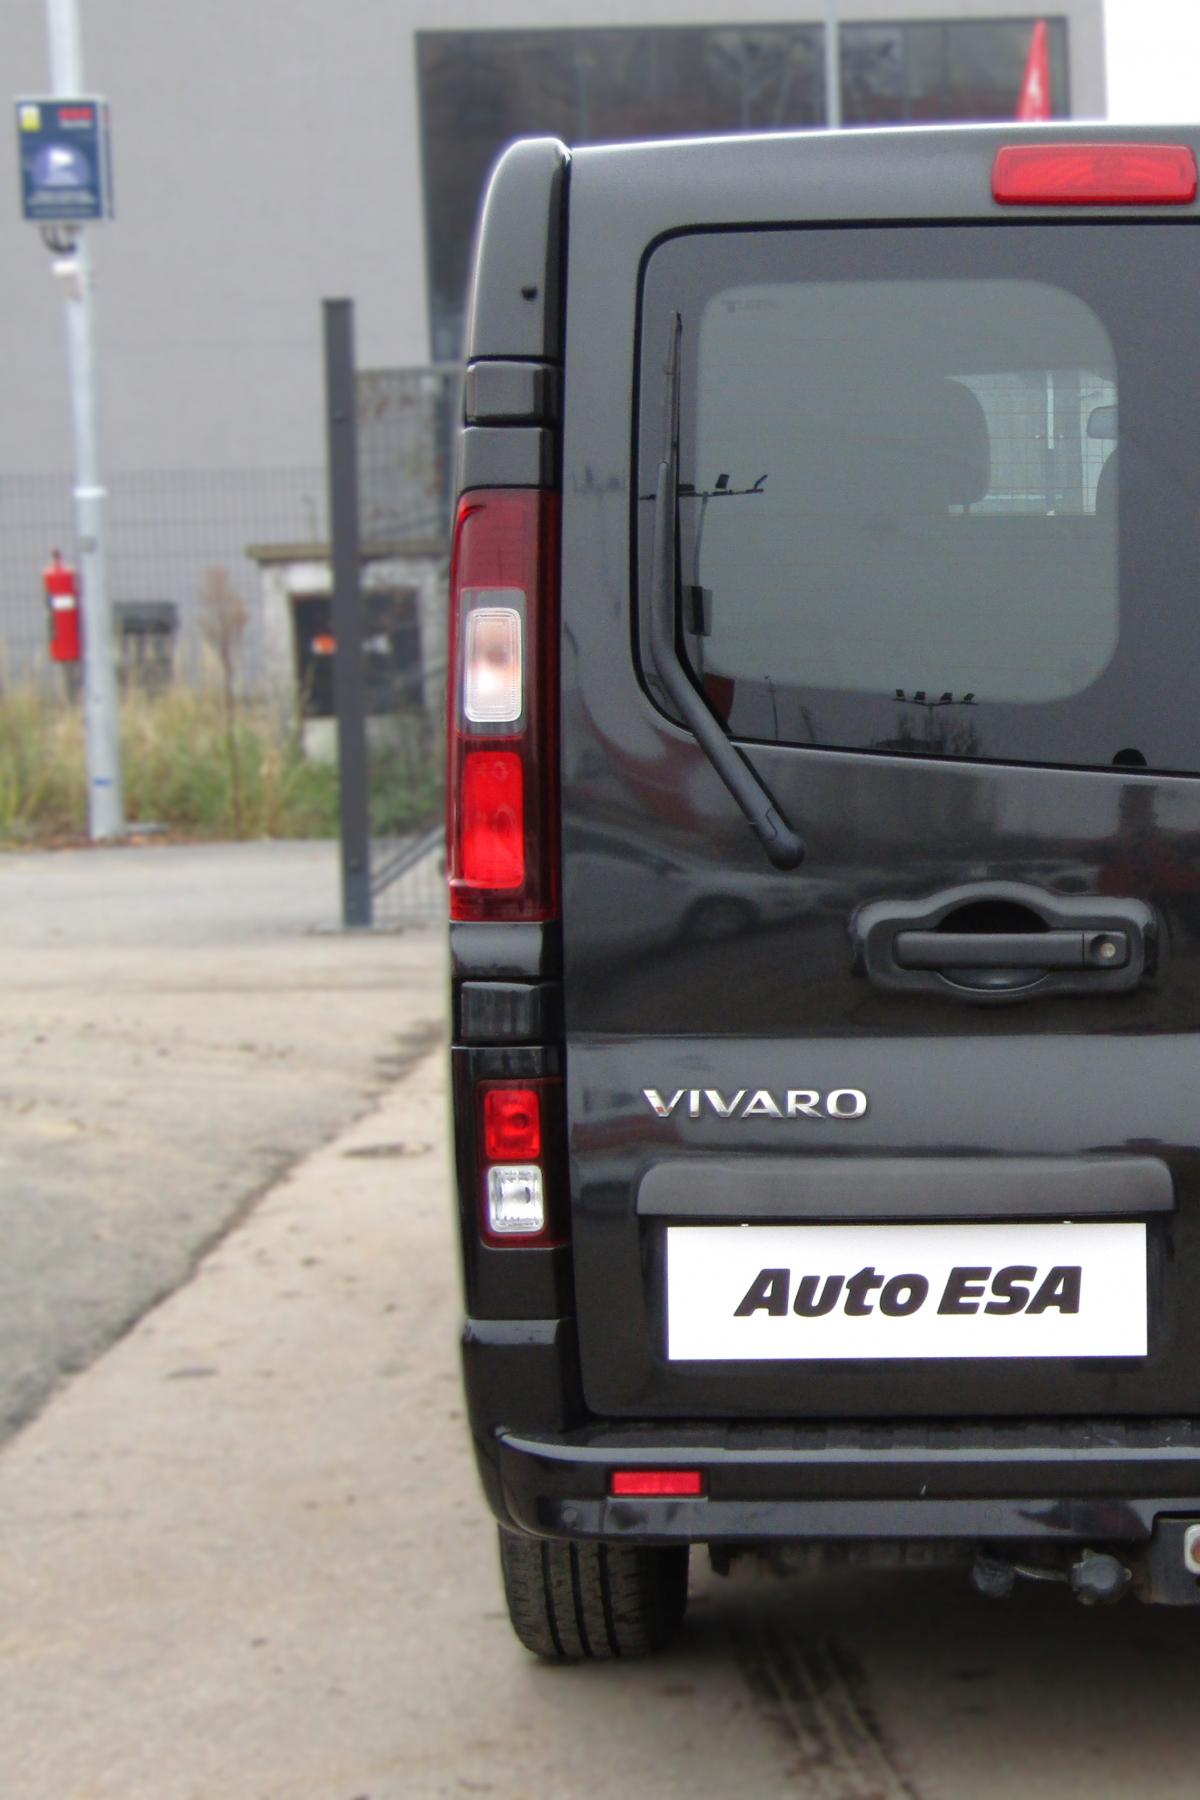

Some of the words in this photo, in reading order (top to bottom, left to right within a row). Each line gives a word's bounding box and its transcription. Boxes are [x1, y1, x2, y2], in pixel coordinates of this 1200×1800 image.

[642, 1088, 868, 1119] VIVARO
[733, 1266, 929, 1317] Auto
[936, 1265, 1082, 1315] ESA
